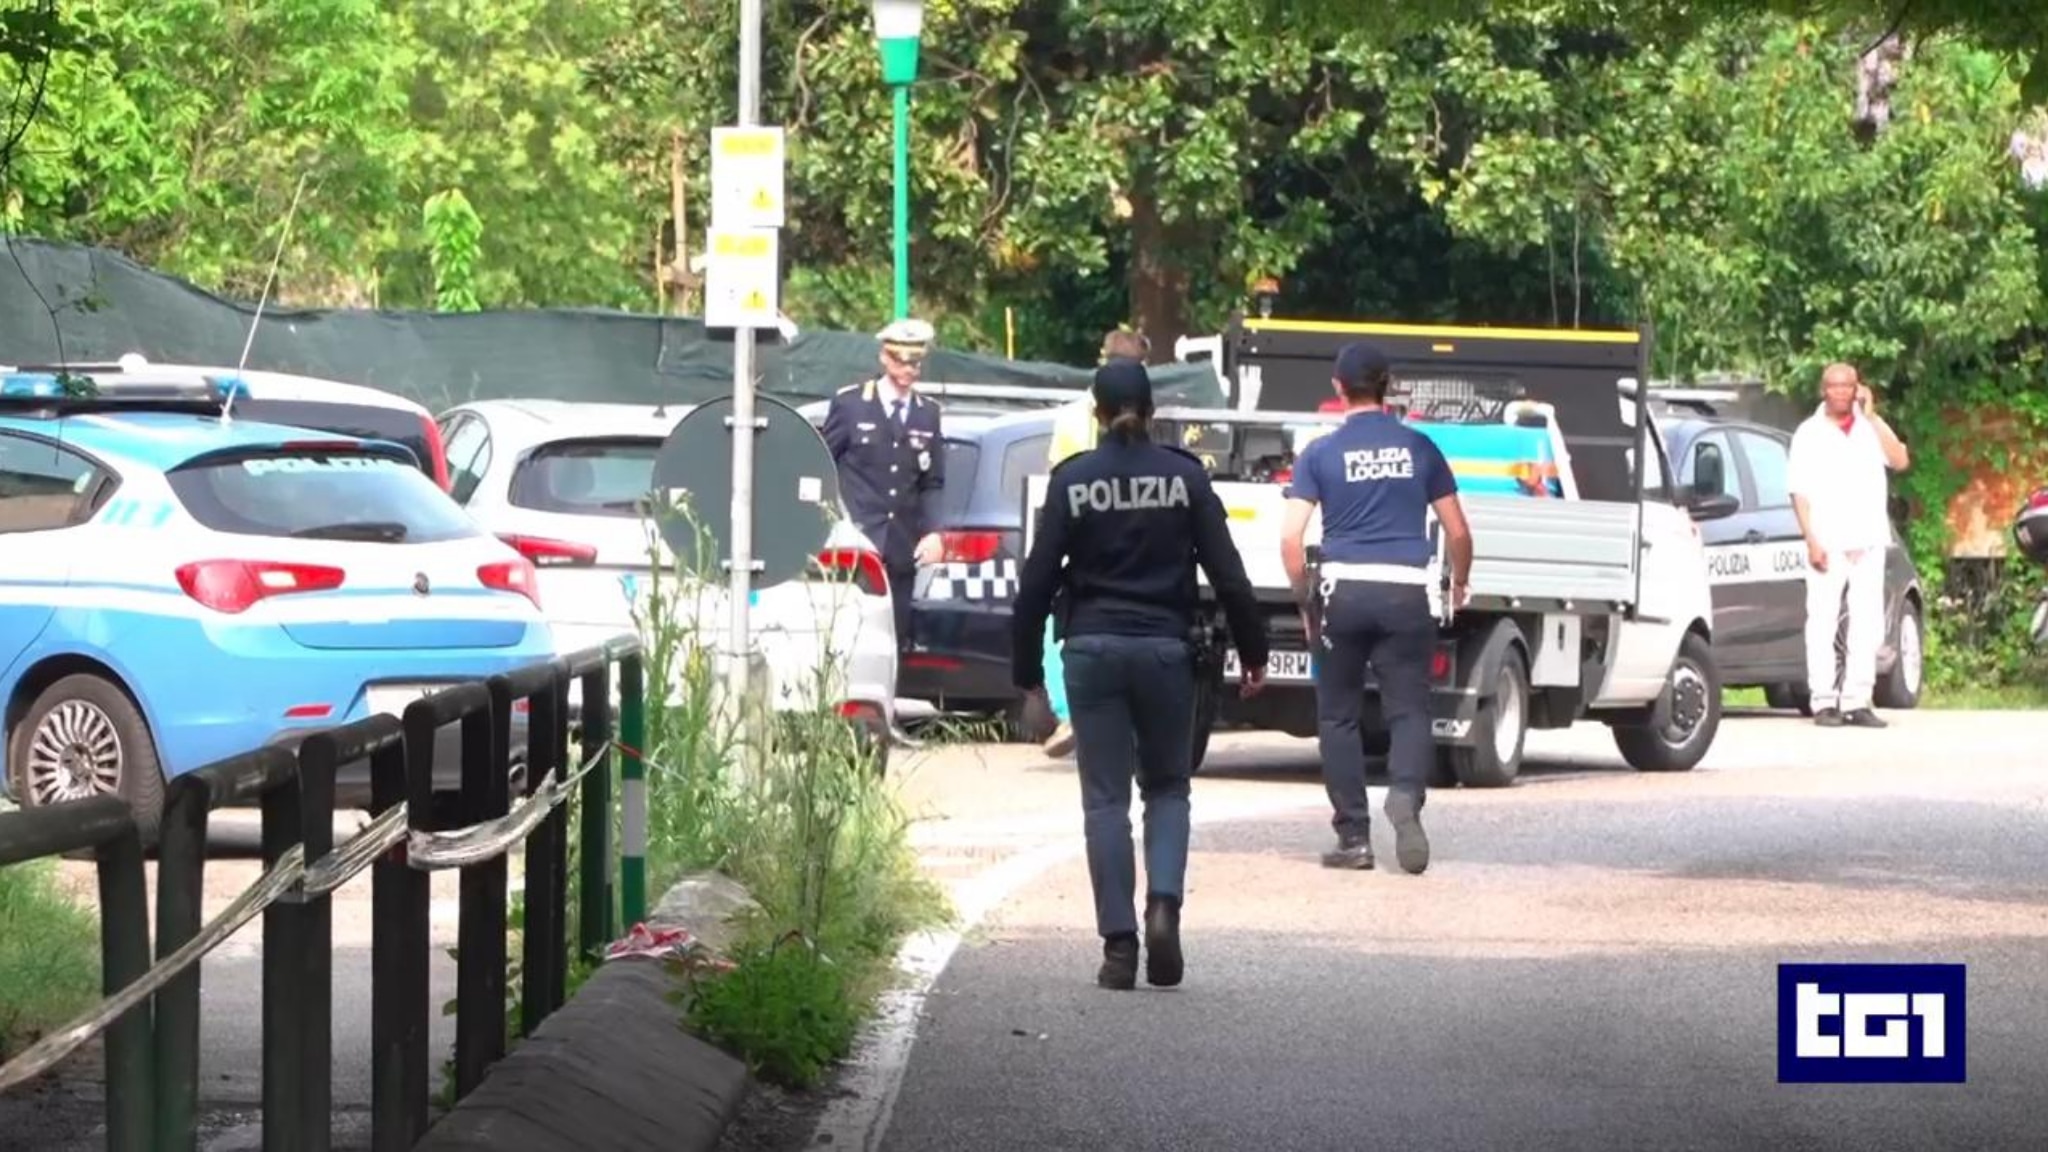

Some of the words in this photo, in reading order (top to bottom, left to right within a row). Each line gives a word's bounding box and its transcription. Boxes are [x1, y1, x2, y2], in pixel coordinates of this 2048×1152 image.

[1344, 447, 1412, 465] POLIZIA
[1346, 463, 1413, 482] LOCALE
[1068, 475, 1189, 517] POLIZIA
[1708, 553, 1751, 576] POLIZIA
[1773, 550, 1807, 572] LOCAL
